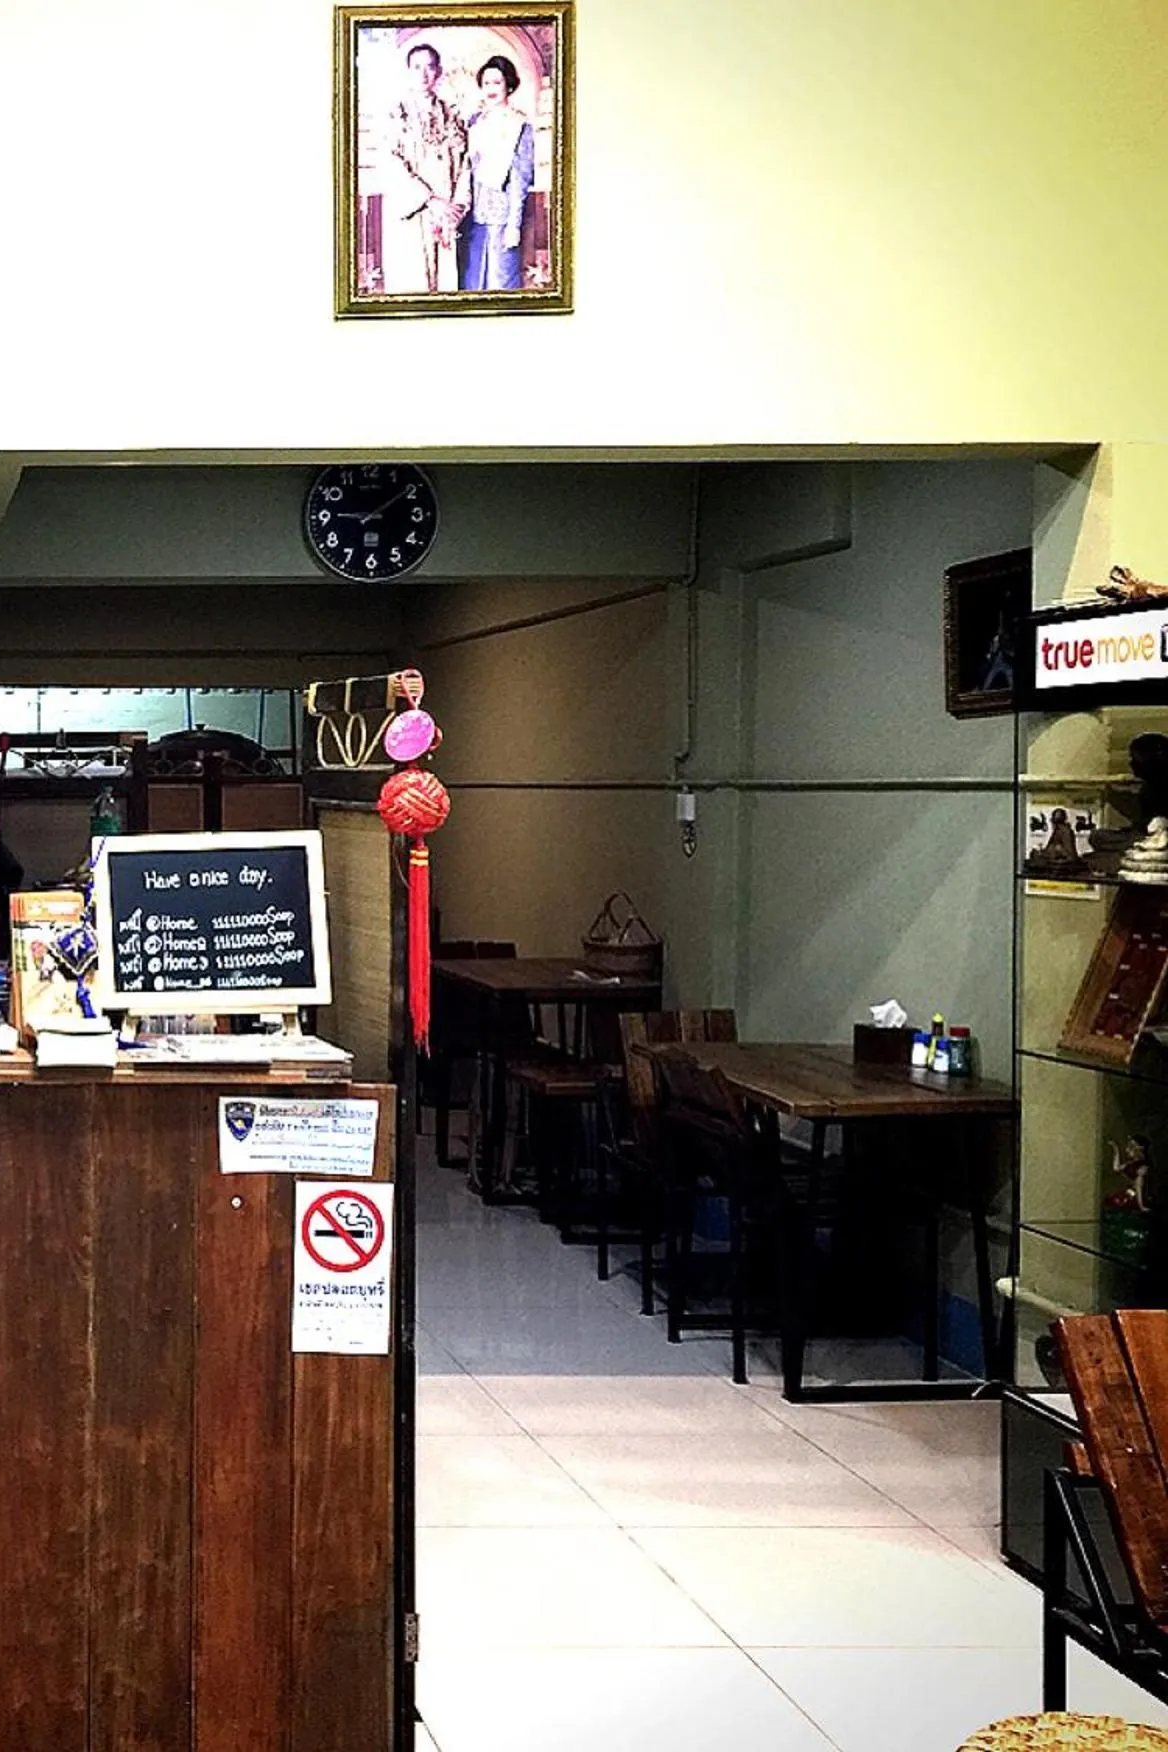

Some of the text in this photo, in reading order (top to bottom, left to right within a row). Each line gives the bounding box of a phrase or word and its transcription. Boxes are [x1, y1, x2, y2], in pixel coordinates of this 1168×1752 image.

[340, 470, 353, 485] 11
[322, 486, 343, 501] 10
[406, 483, 417, 499] 2
[318, 509, 331, 527] 9
[411, 507, 423, 523] 3
[326, 531, 339, 548] 8
[405, 531, 417, 545] 4
[343, 547, 354, 564] 7
[365, 553, 378, 569] 6
[389, 547, 401, 563] 5
[143, 870, 182, 890] Have
[189, 874, 200, 887] a
[202, 869, 229, 887] nice
